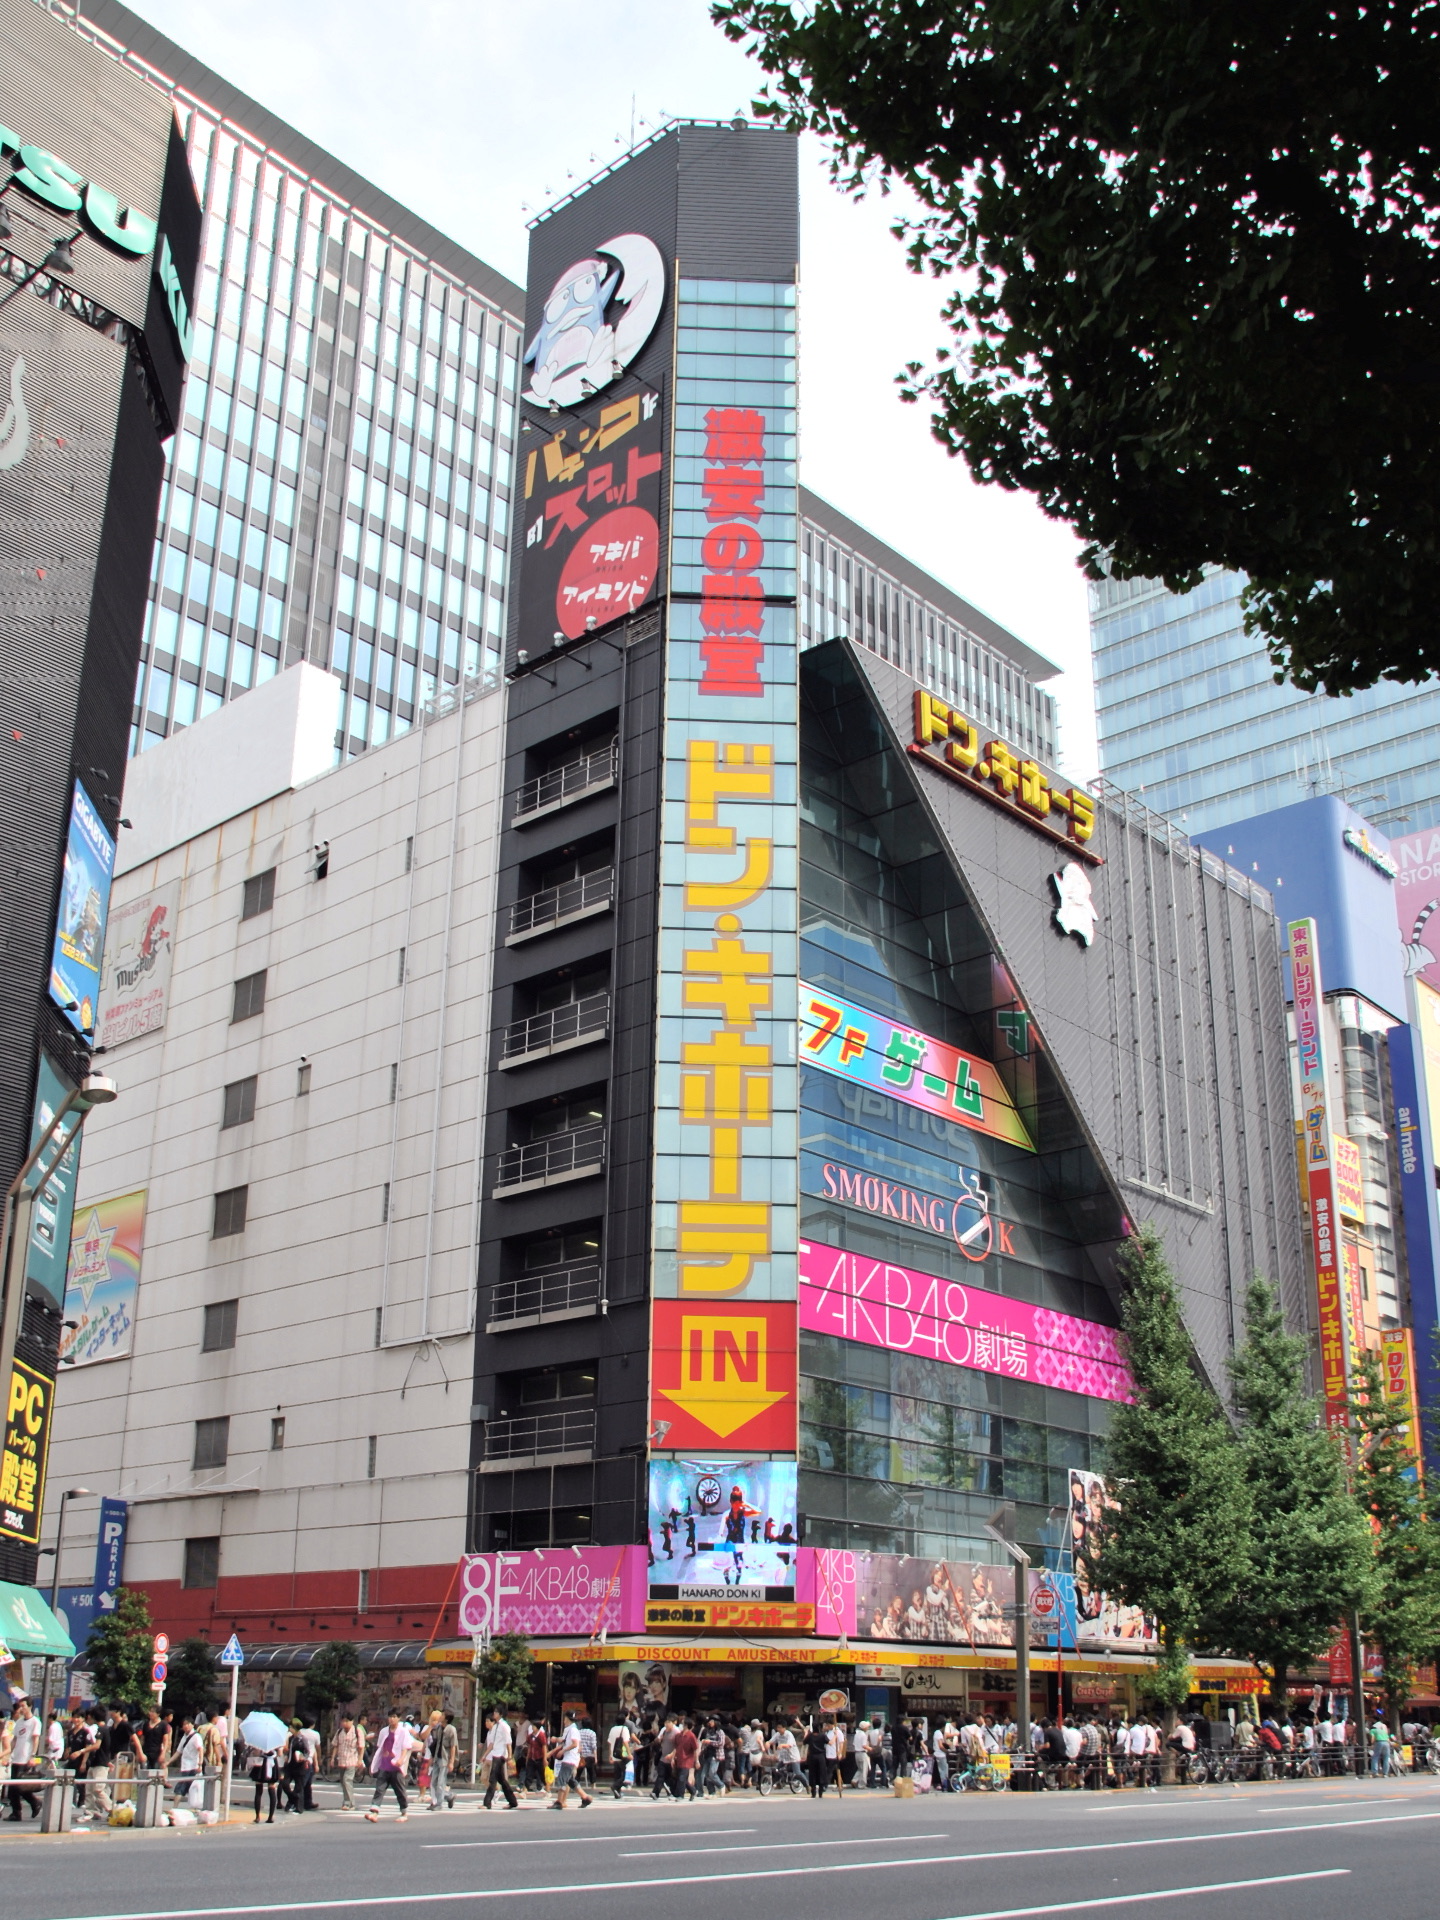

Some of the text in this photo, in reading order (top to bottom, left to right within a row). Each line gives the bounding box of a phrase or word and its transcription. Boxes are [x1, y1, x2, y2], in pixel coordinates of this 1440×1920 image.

[525, 392, 659, 500] パチンコ 1F
[526, 446, 663, 550] B1 スロット
[590, 536, 643, 563] アキバ
[699, 408, 766, 699] 激安の殿堂
[563, 575, 648, 605] アイランド
[75, 791, 113, 865] GIGABYTE
[676, 739, 774, 1299] ドン・キホーテ
[804, 999, 984, 1120] 7F ゲーム
[1307, 1105, 1327, 1163] ゲーム
[1397, 1106, 1417, 1174] animate
[822, 1162, 945, 1234] SMOKING
[85, 1238, 100, 1253] 東京
[1315, 1198, 1333, 1268] 激安の殿堂
[112, 1317, 131, 1347] ゲーム
[816, 1253, 1028, 1377] AKB48劇場
[1318, 1272, 1346, 1398] ドン・キホーテ
[690, 1330, 758, 1382] IN
[1387, 1352, 1406, 1394] DVD
[7, 1370, 44, 1435] PC
[8, 1428, 37, 1457] パーツの
[0, 1449, 37, 1512] 殿堂
[104, 1522, 122, 1586] PARKING
[519, 1564, 621, 1601] AKB48劇場
[817, 1549, 856, 1584] AKB
[682, 1586, 761, 1599] HANARO DON KI
[817, 1581, 845, 1616] 48
[637, 1648, 817, 1661] DISCOUNT AMUSEMENT
